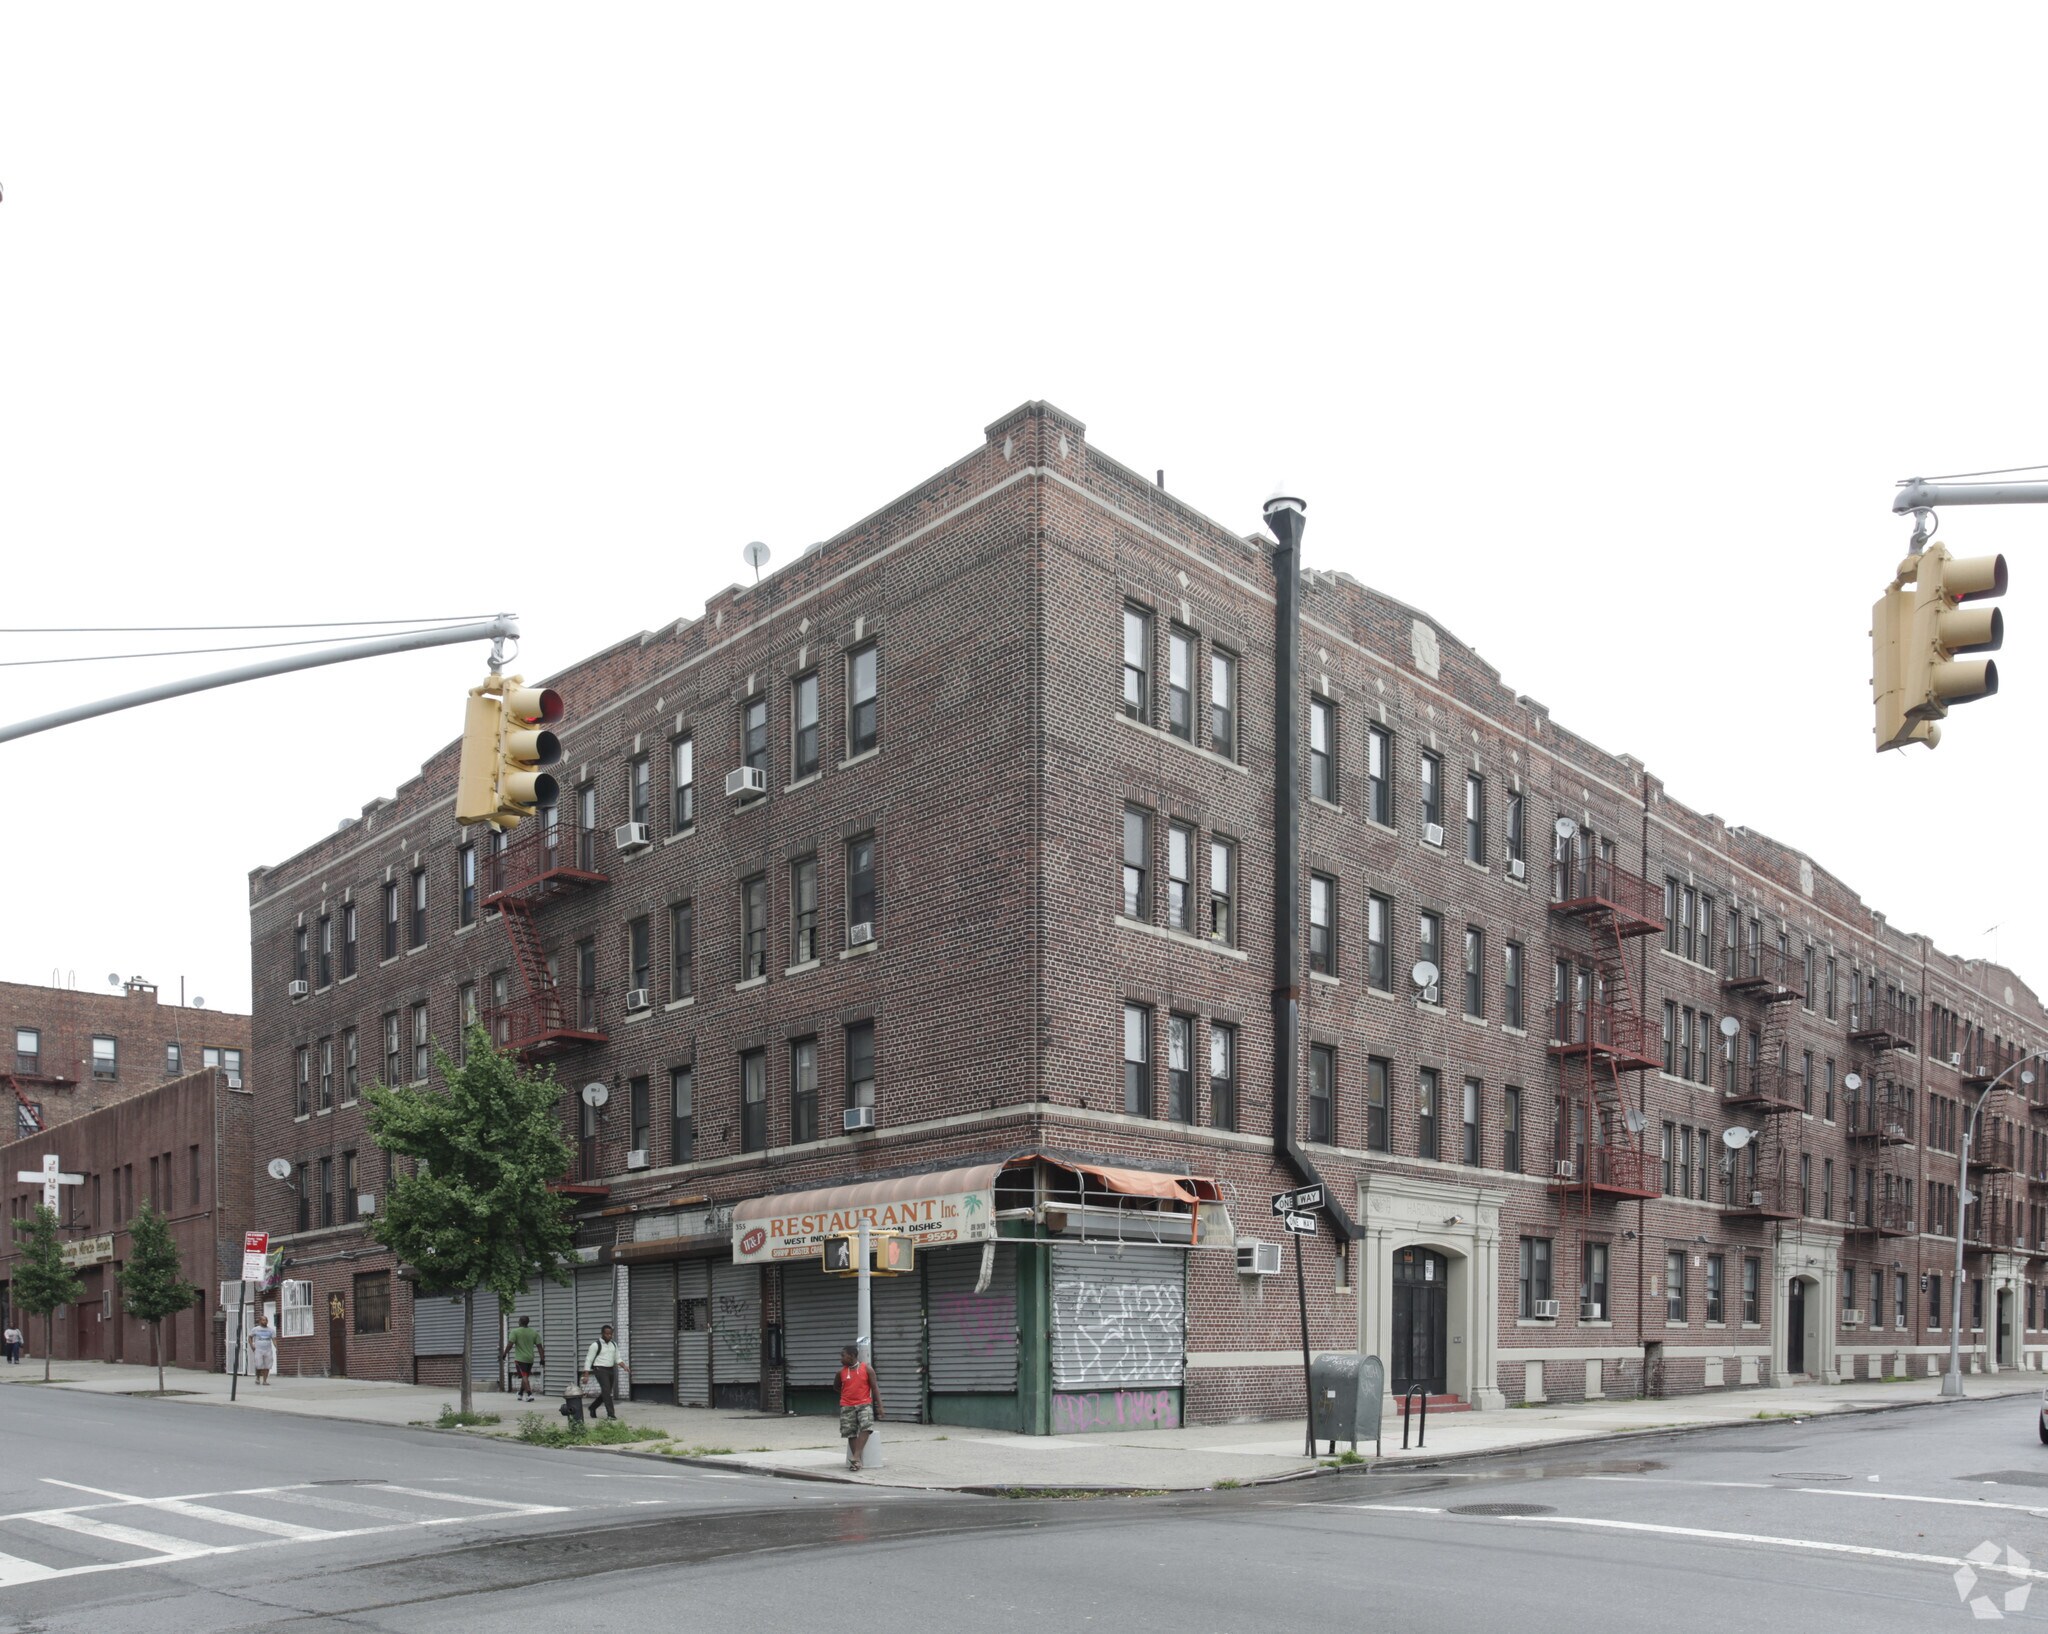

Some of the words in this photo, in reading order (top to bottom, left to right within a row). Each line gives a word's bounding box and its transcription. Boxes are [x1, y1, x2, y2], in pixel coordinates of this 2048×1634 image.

[1280, 1196, 1293, 1209] ONE
[1300, 1192, 1316, 1204] WAY
[770, 1199, 937, 1238] RESTAURANT
[941, 1200, 959, 1219] Inc.
[1289, 1216, 1299, 1227] ONE
[1302, 1219, 1313, 1227] WAY
[743, 1231, 763, 1252] W&P
[784, 1236, 806, 1246] WEST
[909, 1221, 942, 1232] DISHES
[790, 1247, 810, 1256] LOBSTER
